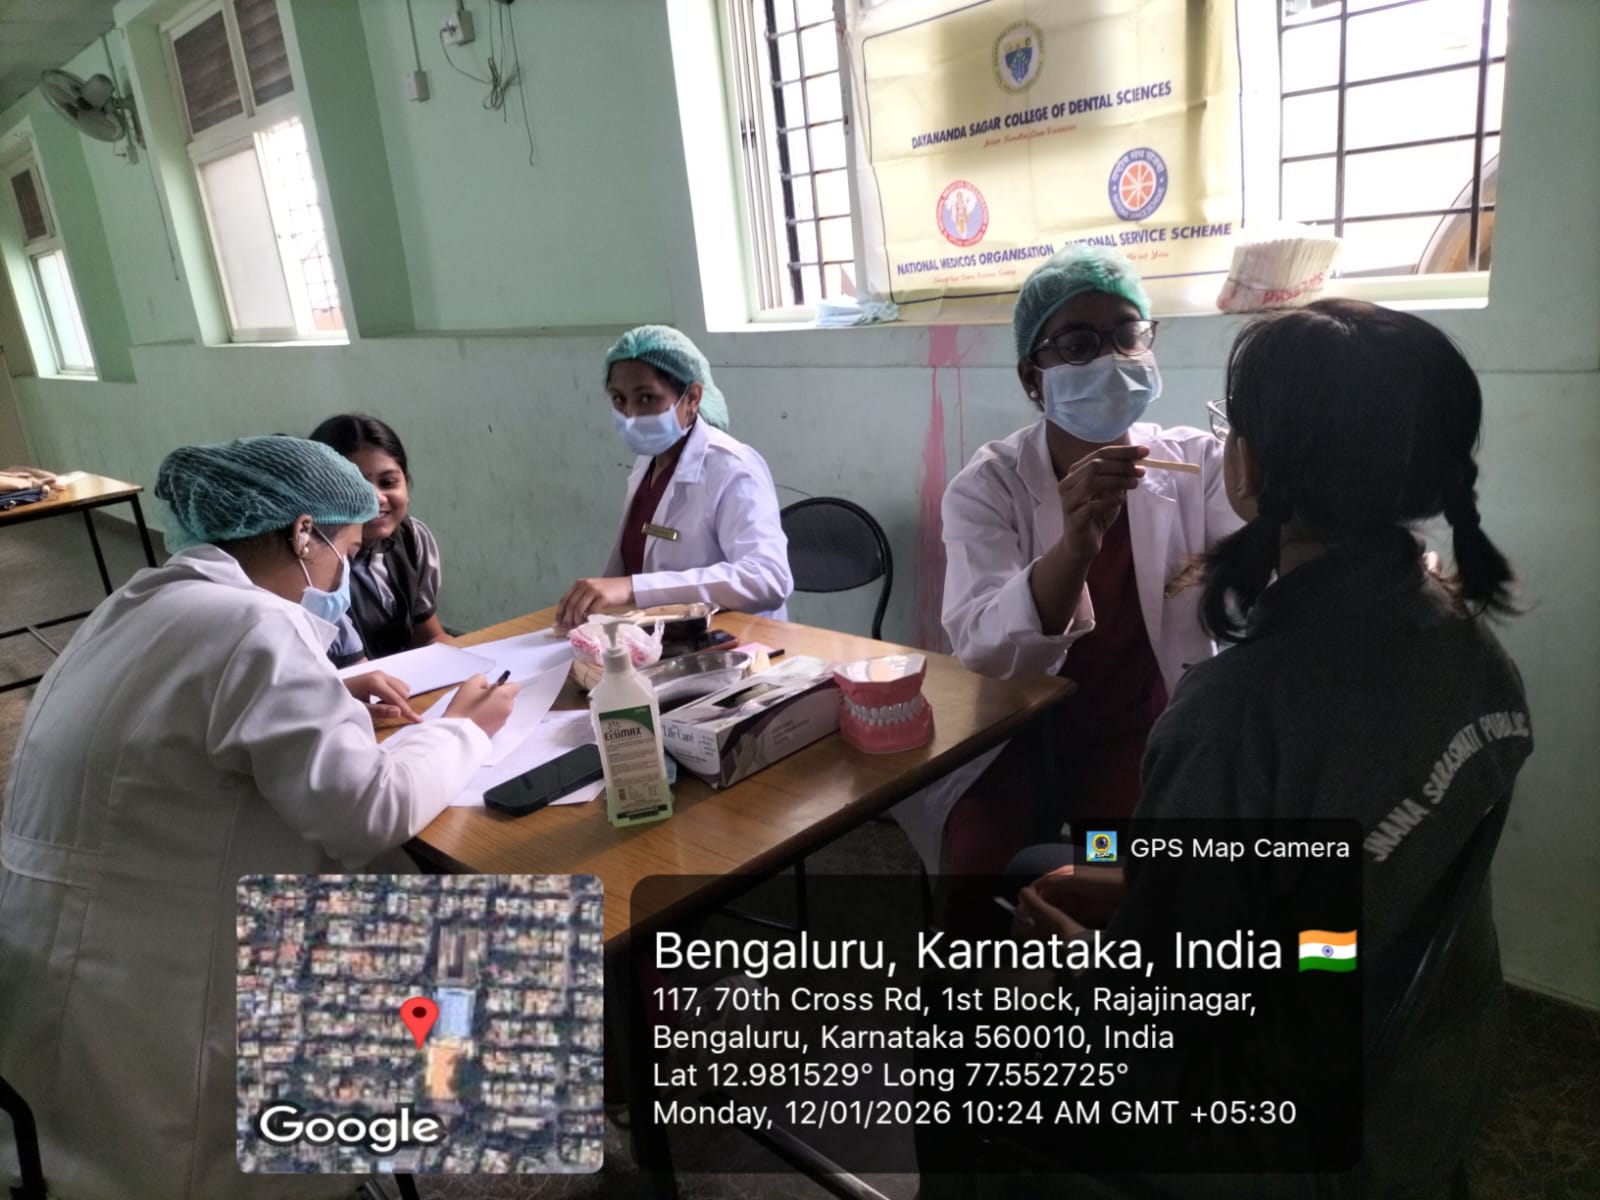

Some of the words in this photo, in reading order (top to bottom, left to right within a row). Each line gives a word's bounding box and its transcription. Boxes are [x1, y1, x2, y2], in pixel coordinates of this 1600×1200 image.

[912, 125, 967, 149] DAYANANDA
[969, 117, 1001, 137] SAGAR
[1004, 106, 1049, 129] COLLEGE
[1051, 104, 1066, 119] OF
[1069, 95, 1113, 116] DENTAL
[1116, 80, 1172, 105] SCIENCES
[897, 257, 940, 276] NATIONAL
[940, 251, 977, 269] MEDICOS
[979, 242, 1055, 264] ORGANISATION
[1119, 228, 1167, 246] SERVICE
[1170, 223, 1232, 240] SCHEME
[1362, 798, 1430, 862] JNANA
